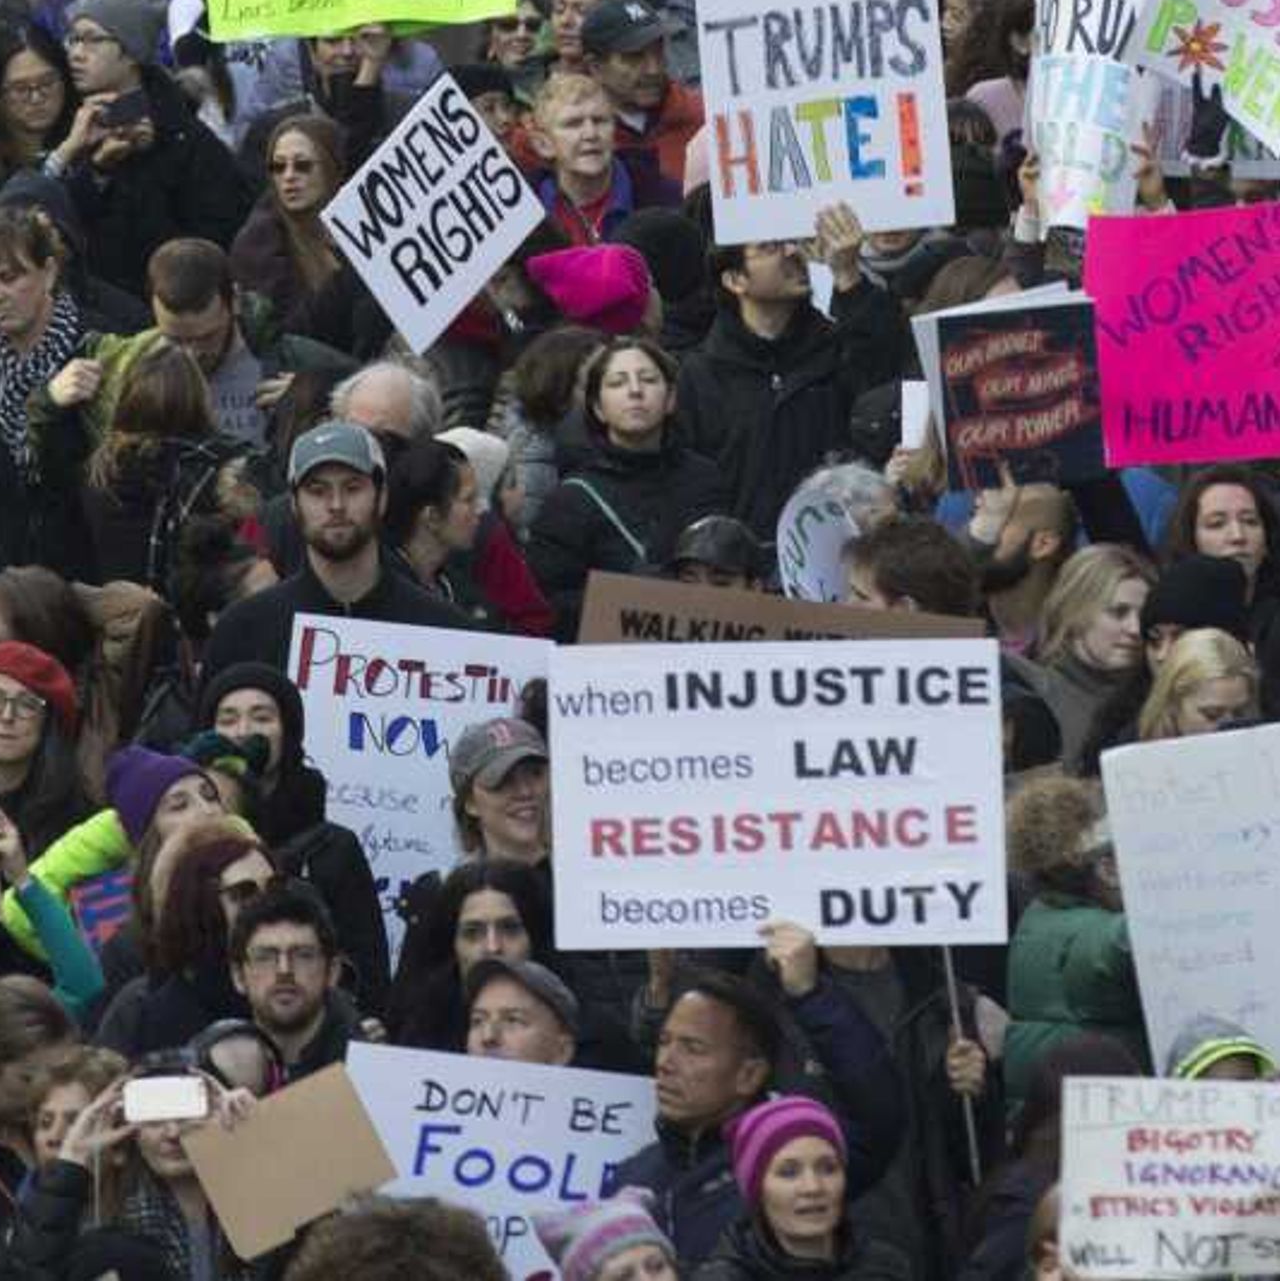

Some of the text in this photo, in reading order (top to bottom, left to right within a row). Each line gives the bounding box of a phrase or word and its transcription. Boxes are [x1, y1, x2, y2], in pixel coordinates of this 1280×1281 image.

[714, 92, 924, 200] HATE!
[330, 88, 480, 260] WOMENS
[388, 146, 523, 306] RIGHTS
[555, 666, 991, 718] when INJUSTICE
[581, 738, 918, 787] becomes LAW
[588, 804, 980, 858] RESISTANCE
[598, 881, 984, 930] becomes DUTY
[415, 1079, 634, 1136] DON'T BE
[1126, 1126, 1262, 1156] BIGOTRY
[1087, 1194, 1179, 1221] ETHICS
[1068, 1241, 1136, 1269] WILL
[1156, 1229, 1240, 1269] NOT
